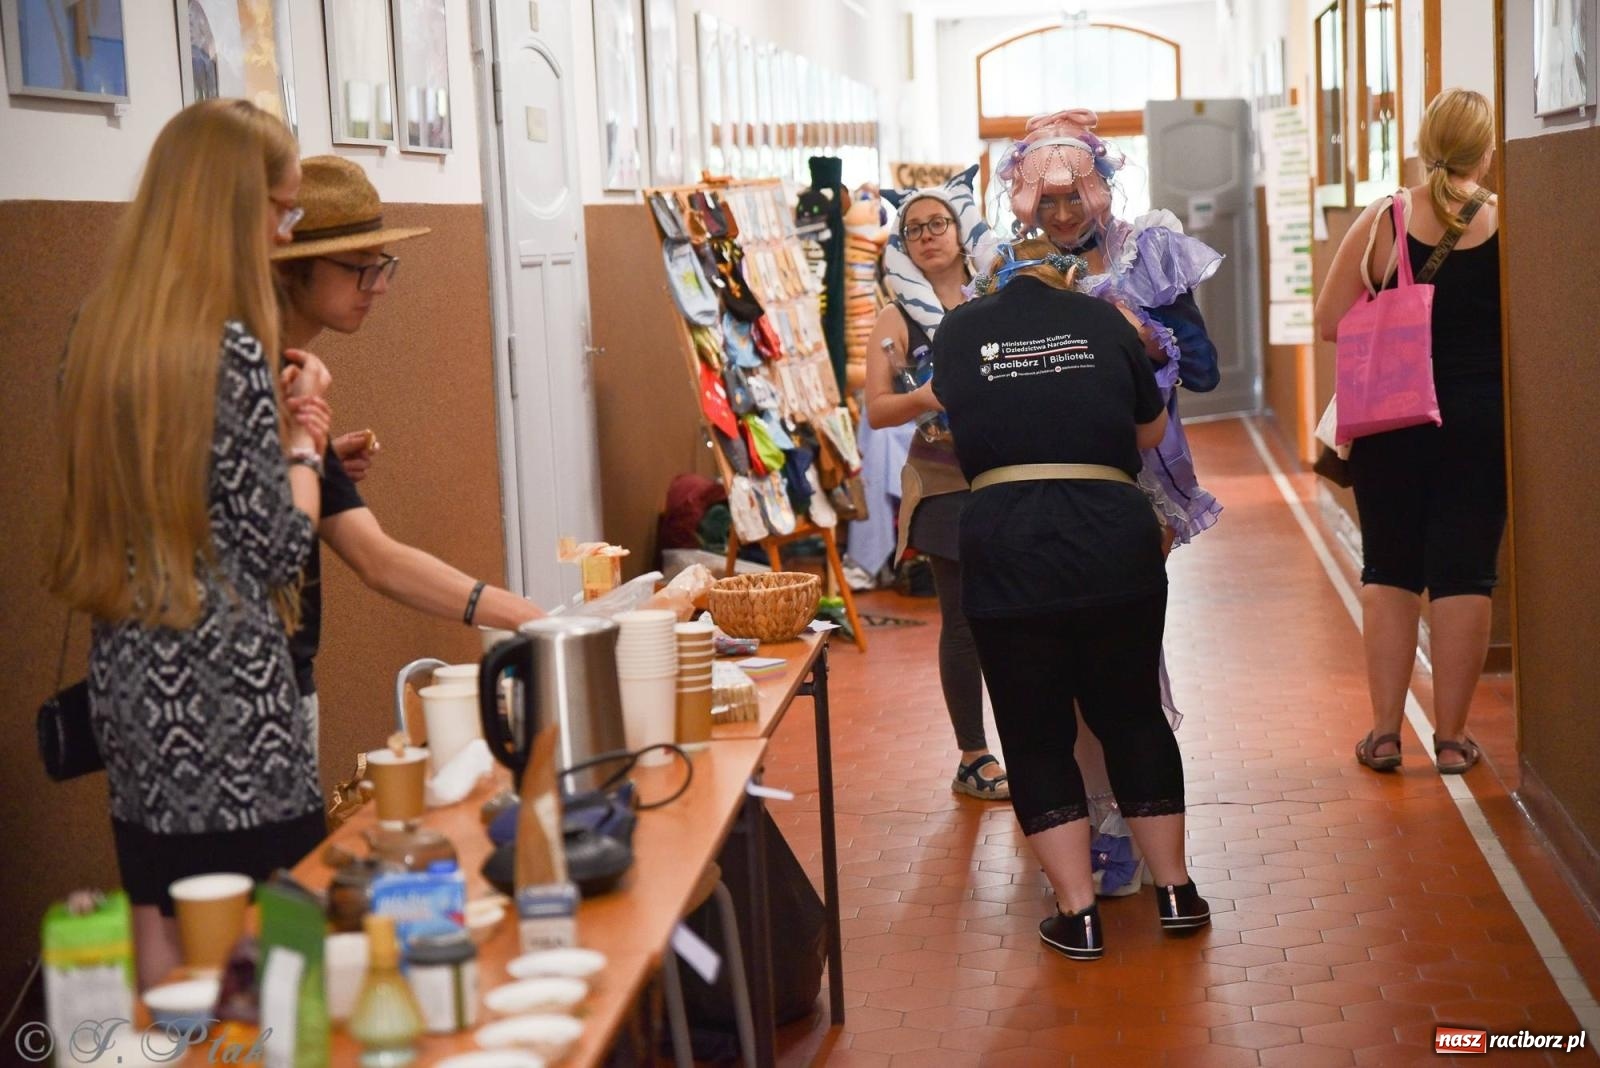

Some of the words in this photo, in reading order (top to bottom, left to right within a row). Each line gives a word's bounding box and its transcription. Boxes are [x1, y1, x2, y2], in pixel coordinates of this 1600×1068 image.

[1001, 338, 1046, 348] Ministerstwo
[1046, 333, 1072, 343] Kultury
[1005, 344, 1047, 354] Dziedzictwa
[1047, 339, 1088, 349] Narodowego
[993, 359, 1039, 371] Racibórz
[1050, 351, 1095, 364] Biblioteka
